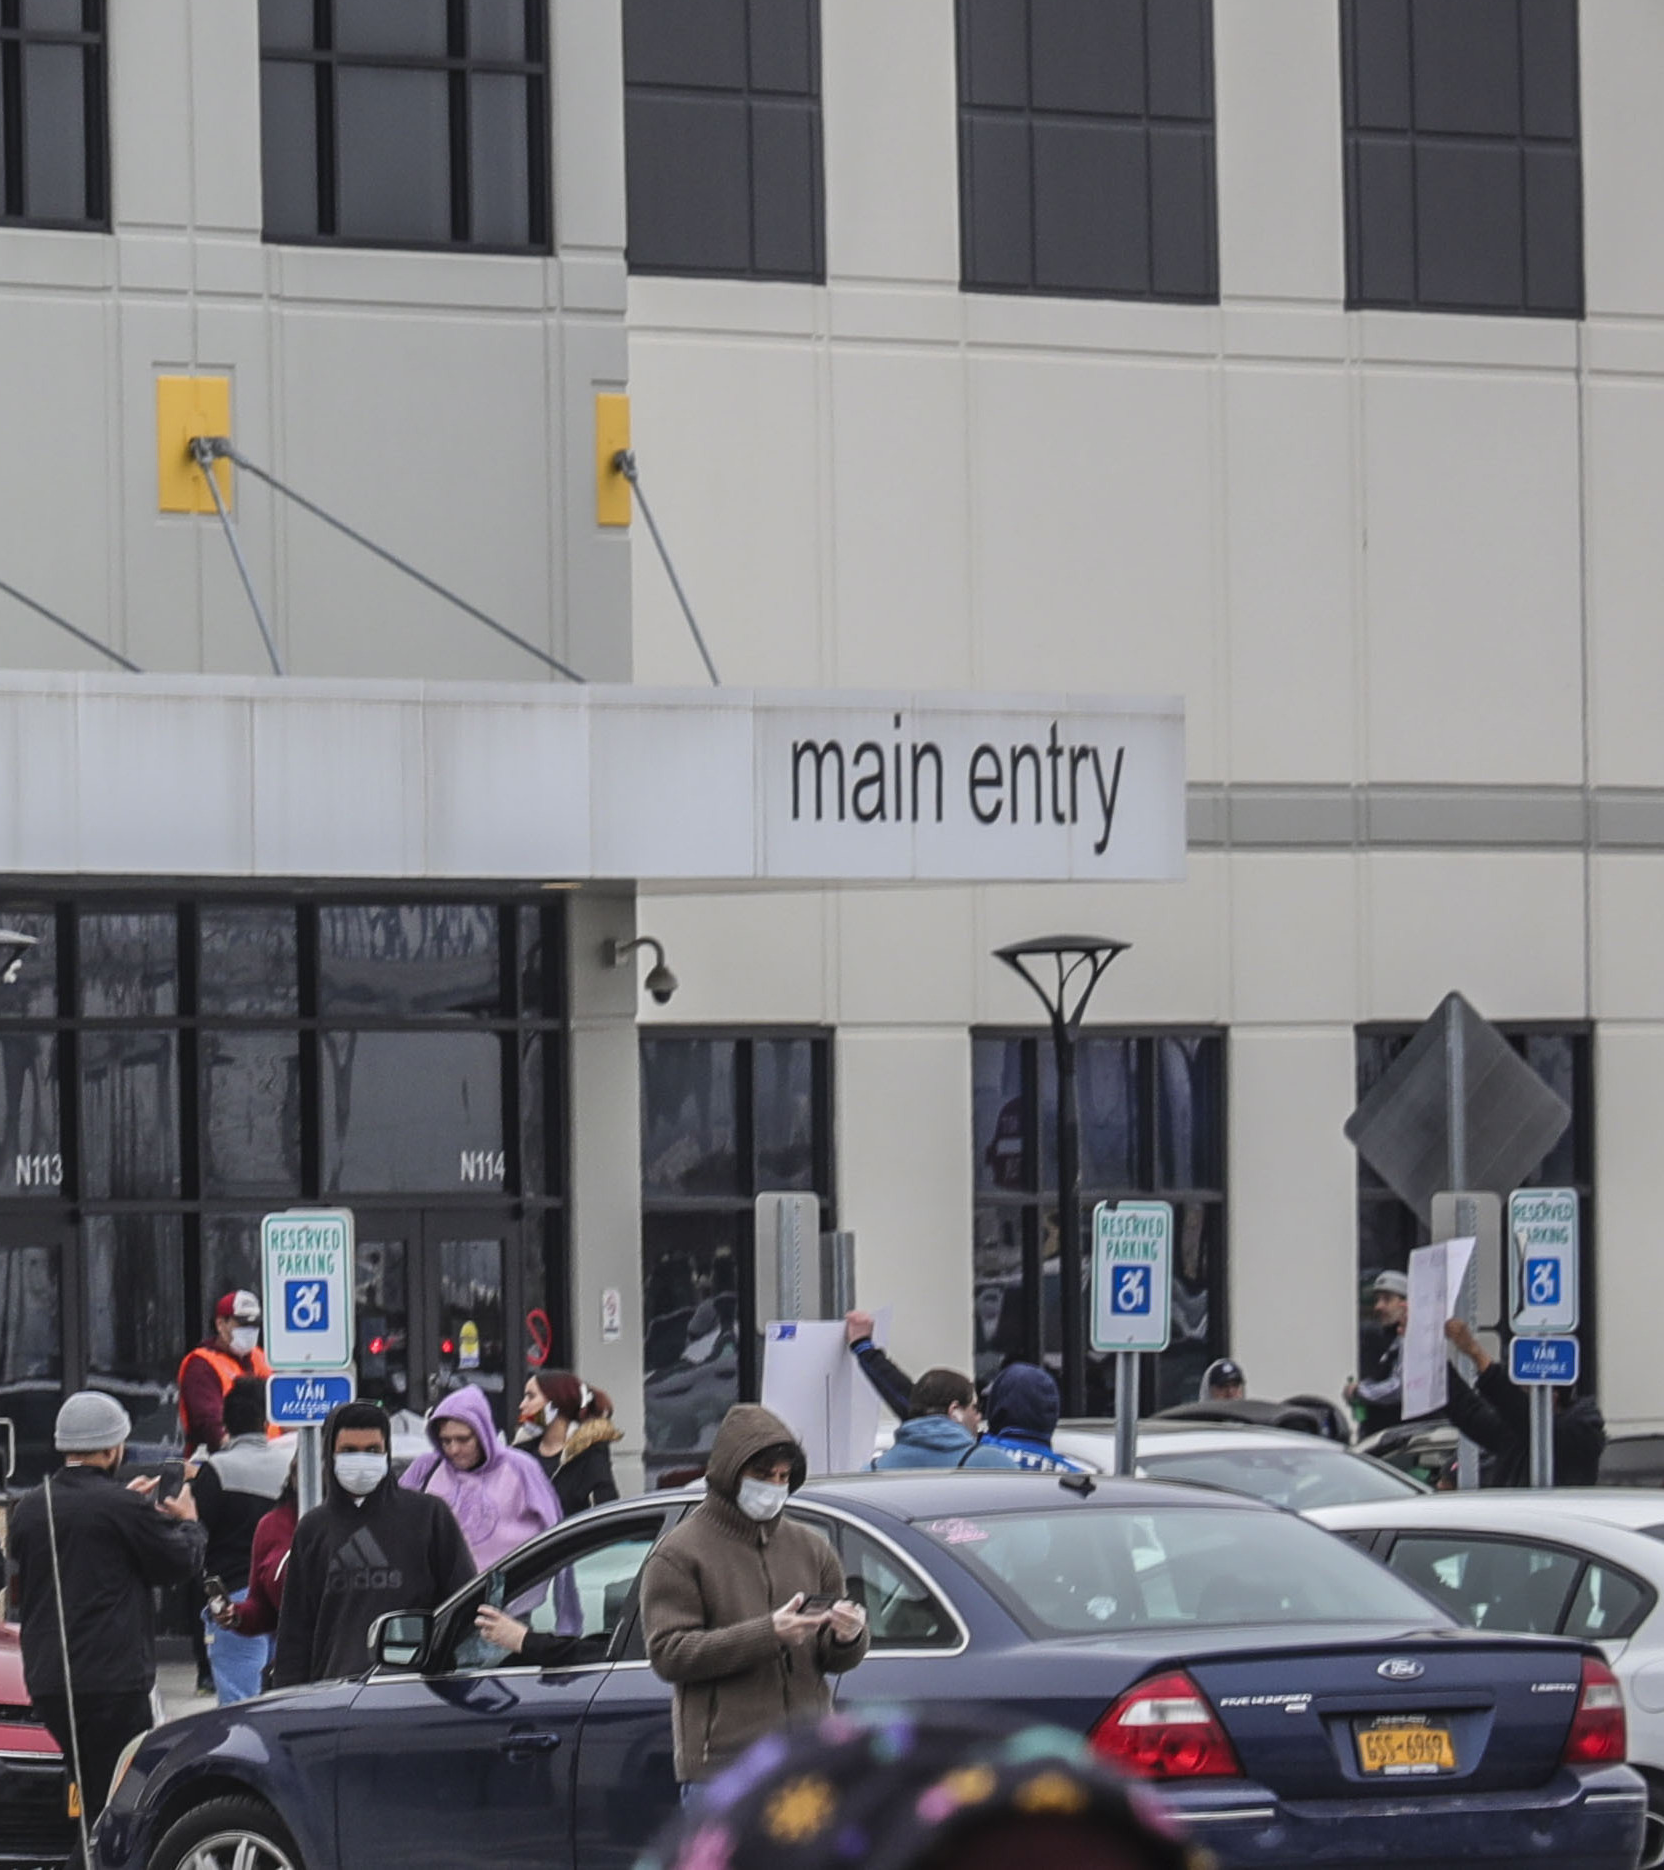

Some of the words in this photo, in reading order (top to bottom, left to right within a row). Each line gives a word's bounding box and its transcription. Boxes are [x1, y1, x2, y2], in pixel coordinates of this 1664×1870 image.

[791, 713, 944, 822] main
[968, 720, 1125, 855] entry
[16, 1153, 64, 1187] N113
[460, 1150, 506, 1182] N114
[1514, 1202, 1573, 1222] RESERVED
[1100, 1215, 1163, 1238] RESERVED
[1528, 1226, 1569, 1244] ARKING
[271, 1228, 340, 1251] RESERVED
[1106, 1239, 1158, 1261] PARKING
[277, 1253, 335, 1276] PARKING
[1532, 1345, 1557, 1361] VAN
[295, 1383, 325, 1400] VAN
